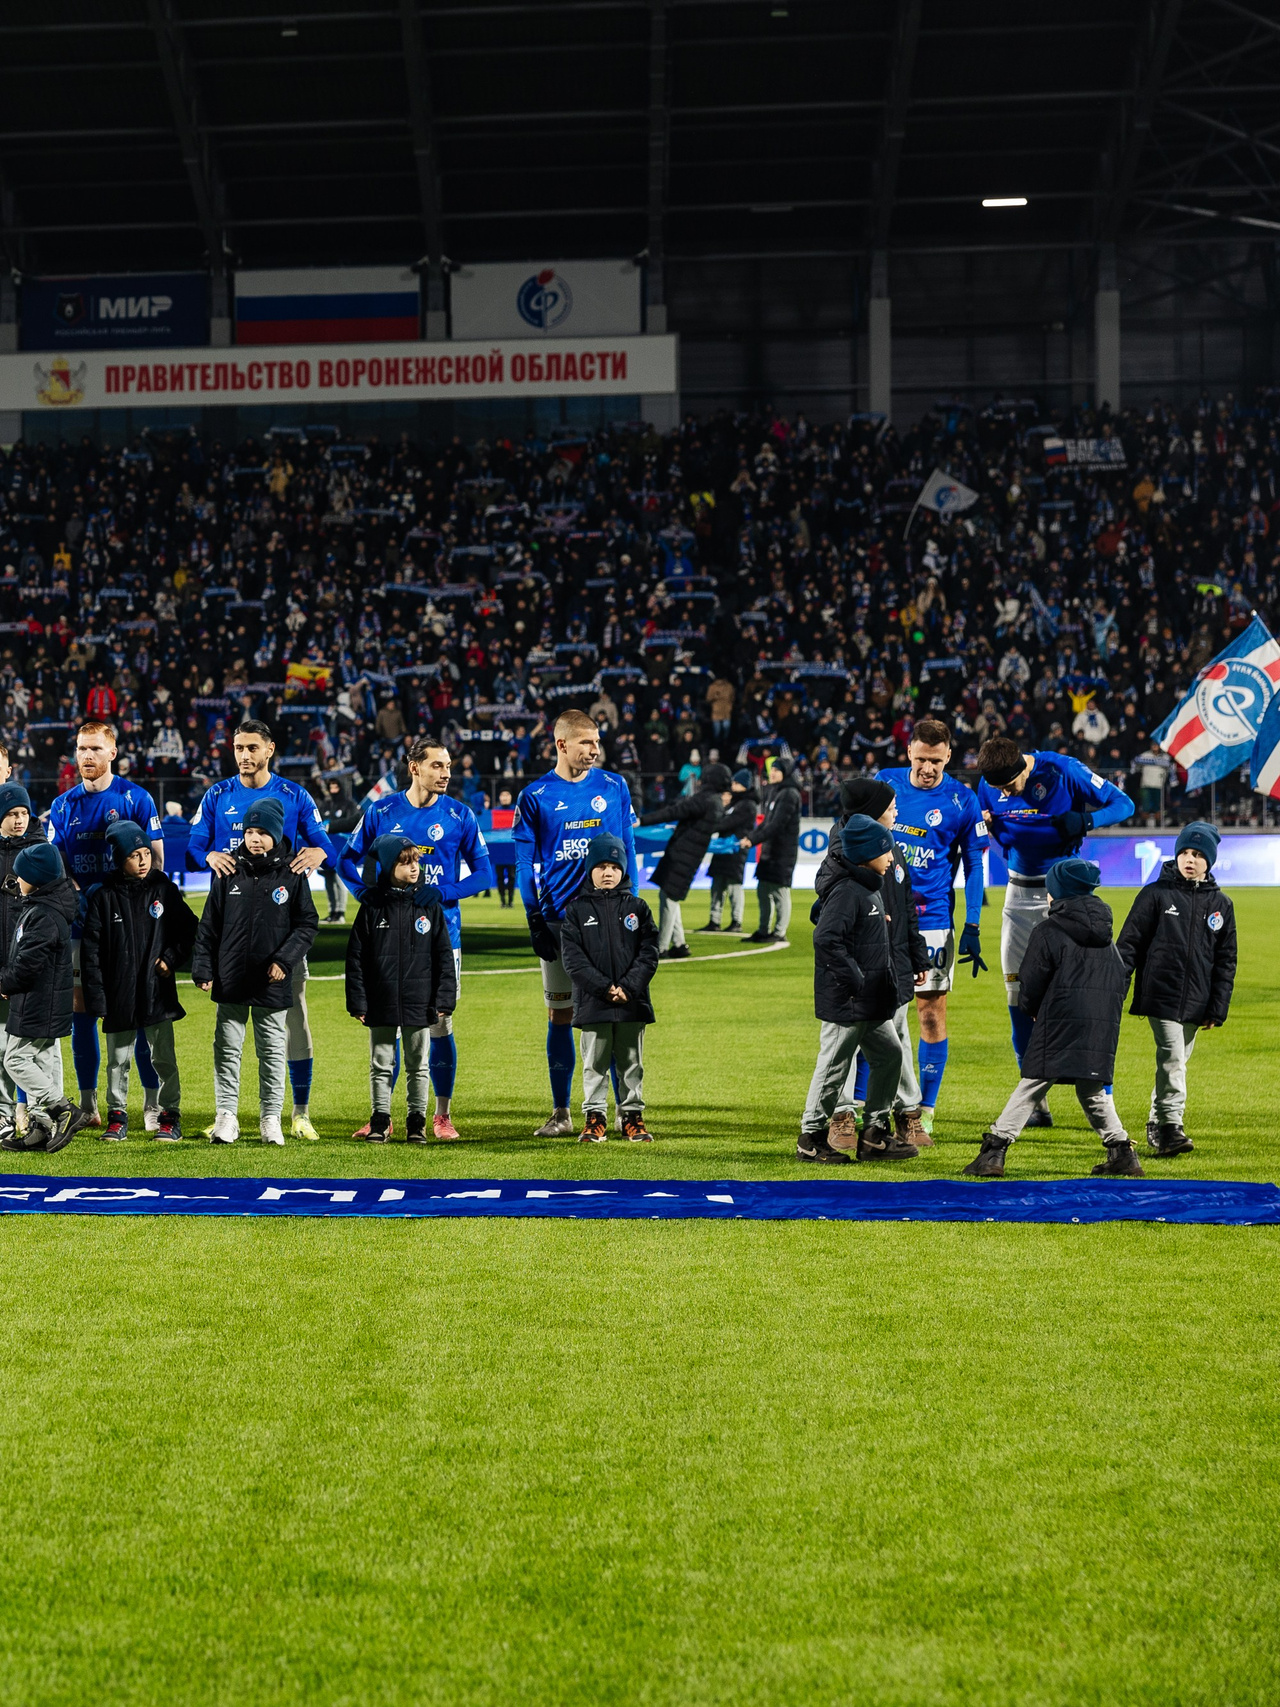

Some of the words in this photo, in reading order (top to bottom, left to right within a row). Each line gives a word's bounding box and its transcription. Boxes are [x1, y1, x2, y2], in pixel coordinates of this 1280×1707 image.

[99, 295, 173, 319] МИР
[105, 360, 311, 393] ПРАВИТЕЛЬСТВО
[318, 349, 504, 388] ВОРОНЕЖСКОЙ
[510, 351, 627, 383] ОБЛАСТИ
[555, 848, 589, 862] ЭКОН
[896, 841, 935, 860] ONIVA
